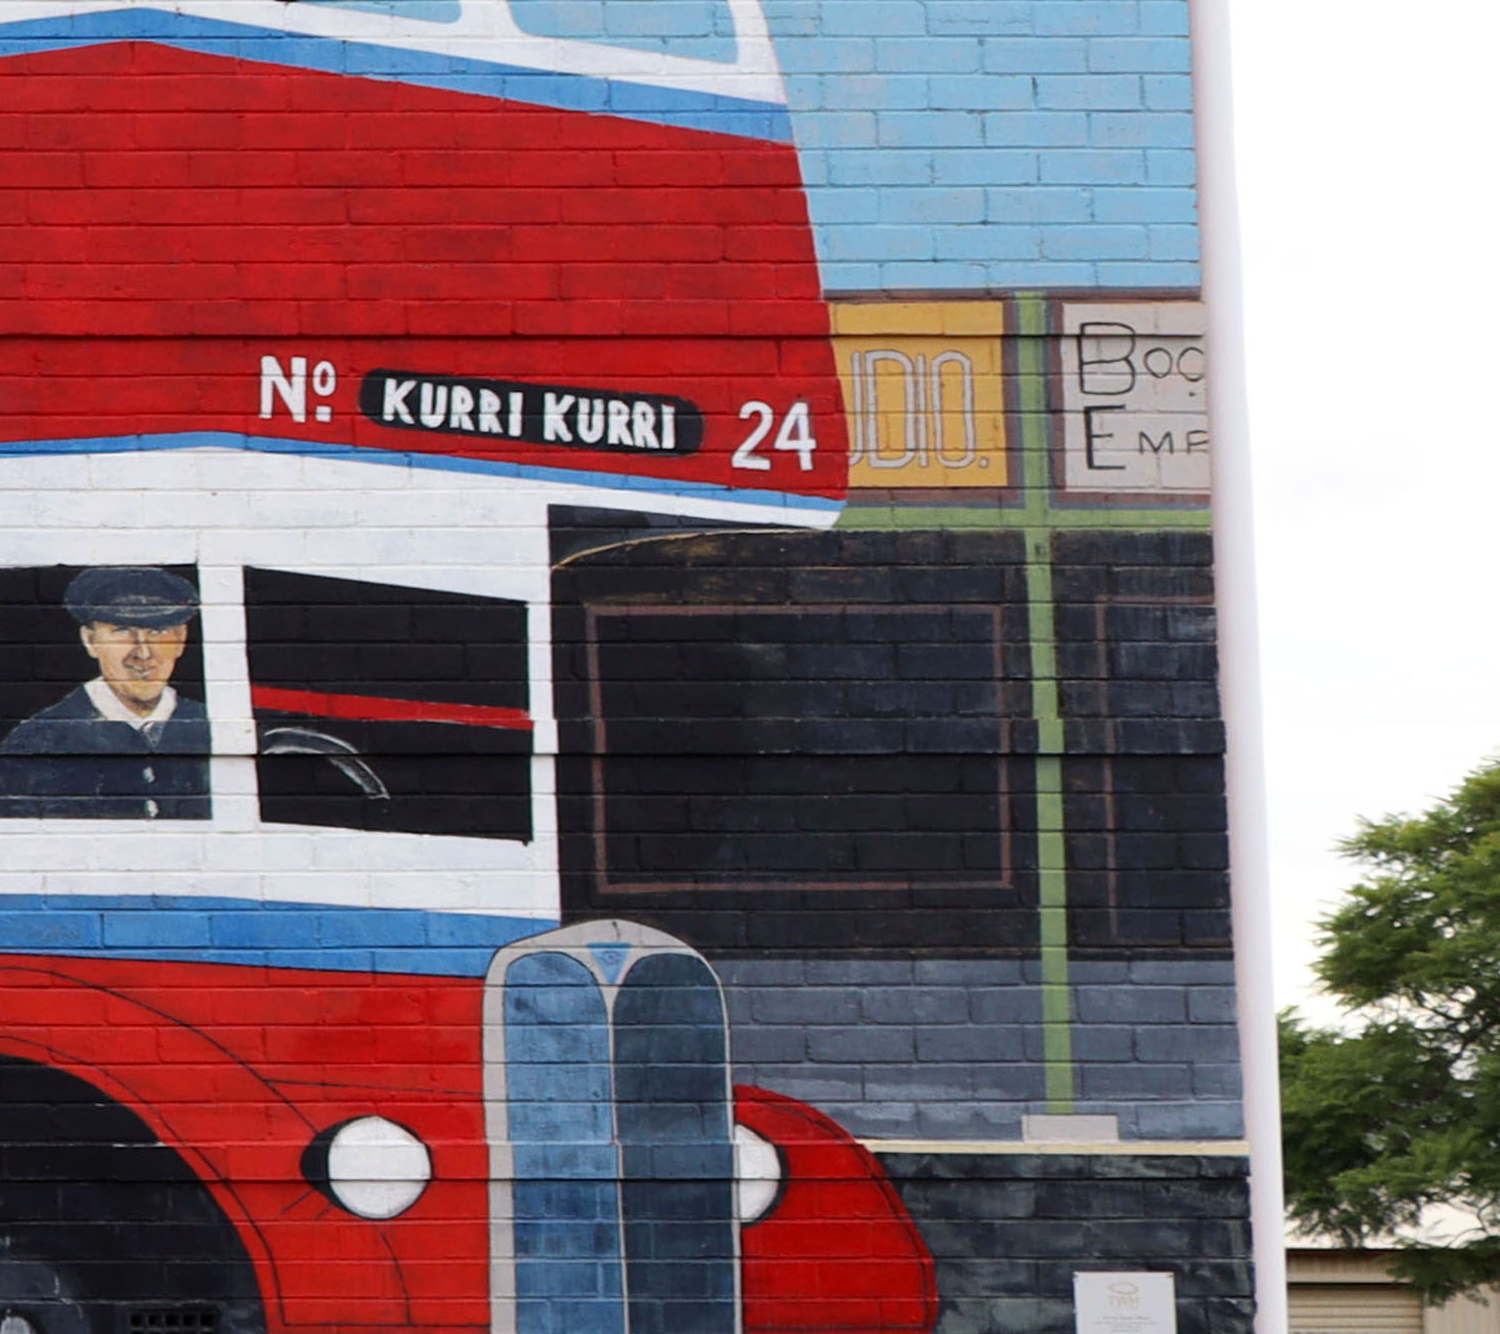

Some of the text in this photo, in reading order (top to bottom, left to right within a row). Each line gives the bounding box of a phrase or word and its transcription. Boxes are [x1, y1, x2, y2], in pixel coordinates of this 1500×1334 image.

[382, 377, 524, 437] KURRI
[541, 390, 676, 450] KURRI
[731, 400, 818, 471] 24
